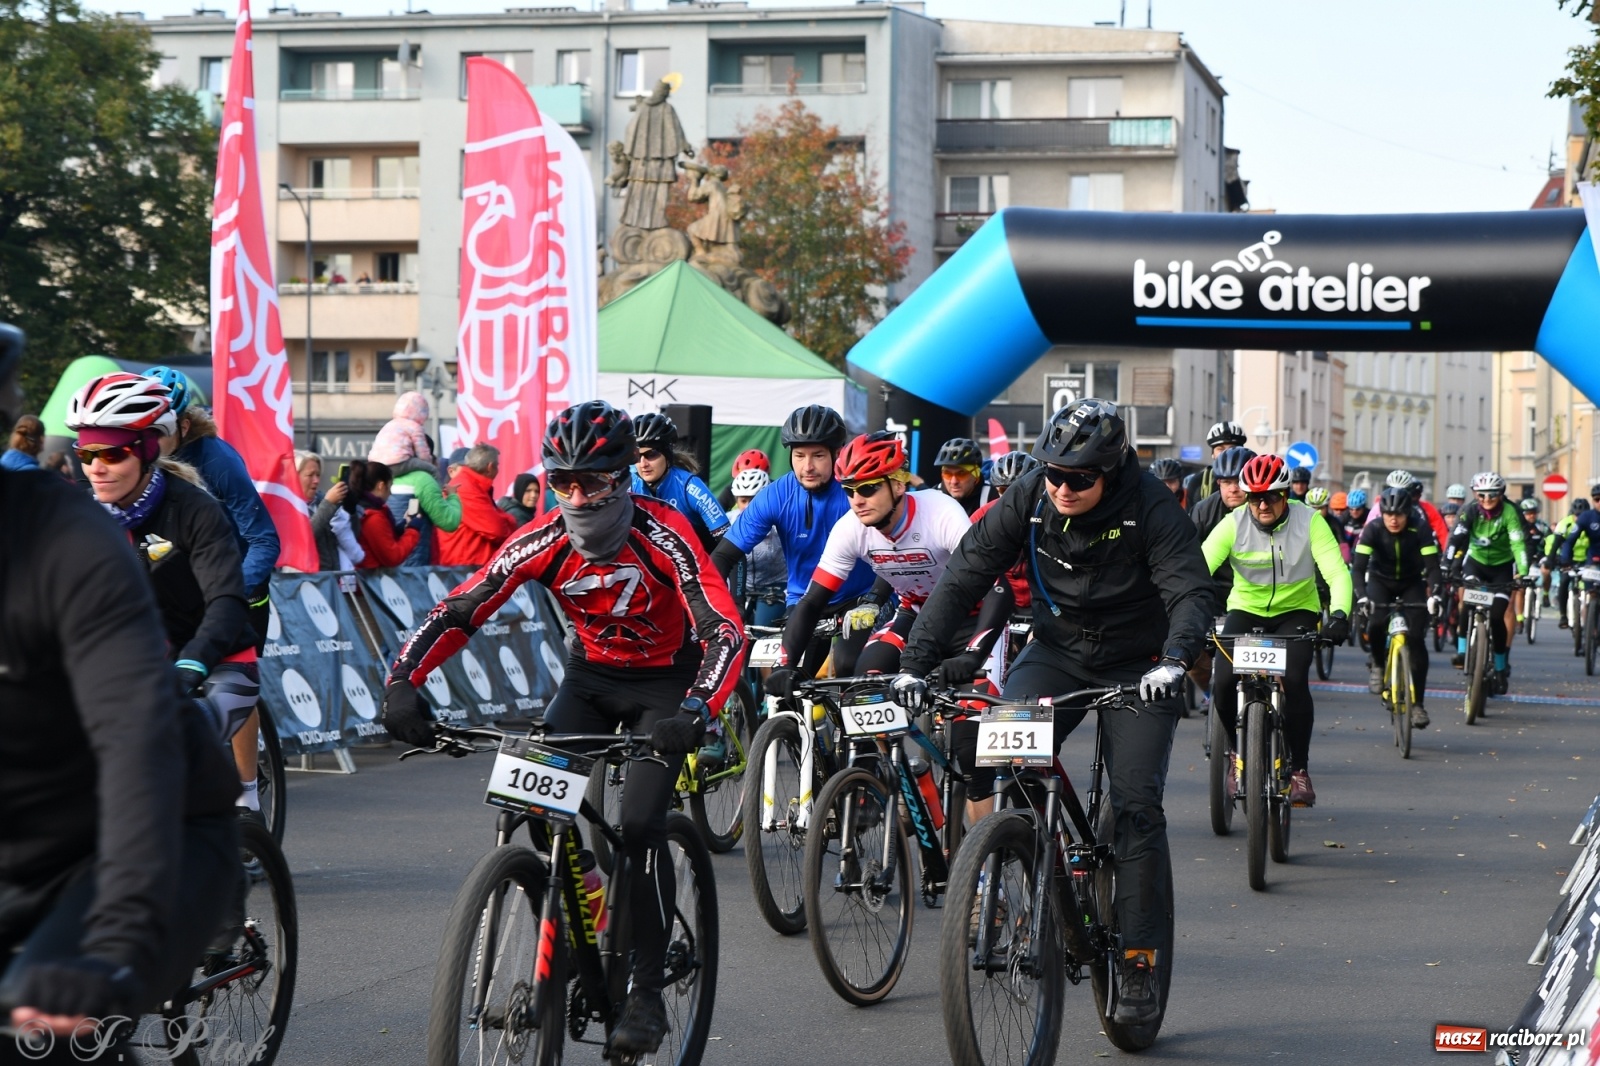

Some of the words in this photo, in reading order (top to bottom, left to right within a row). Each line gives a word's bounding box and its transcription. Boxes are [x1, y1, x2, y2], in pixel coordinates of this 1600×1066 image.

[1133, 258, 1244, 311] bike
[1258, 261, 1432, 313] atelier
[1049, 379, 1080, 388] SEKTOR
[1068, 403, 1094, 427] FOX
[320, 436, 376, 458] MAT
[871, 552, 931, 565] SPIDER
[1242, 651, 1276, 664] 3192
[854, 707, 896, 727] 3220
[987, 731, 1037, 750] 2151
[507, 767, 570, 801] 1083
